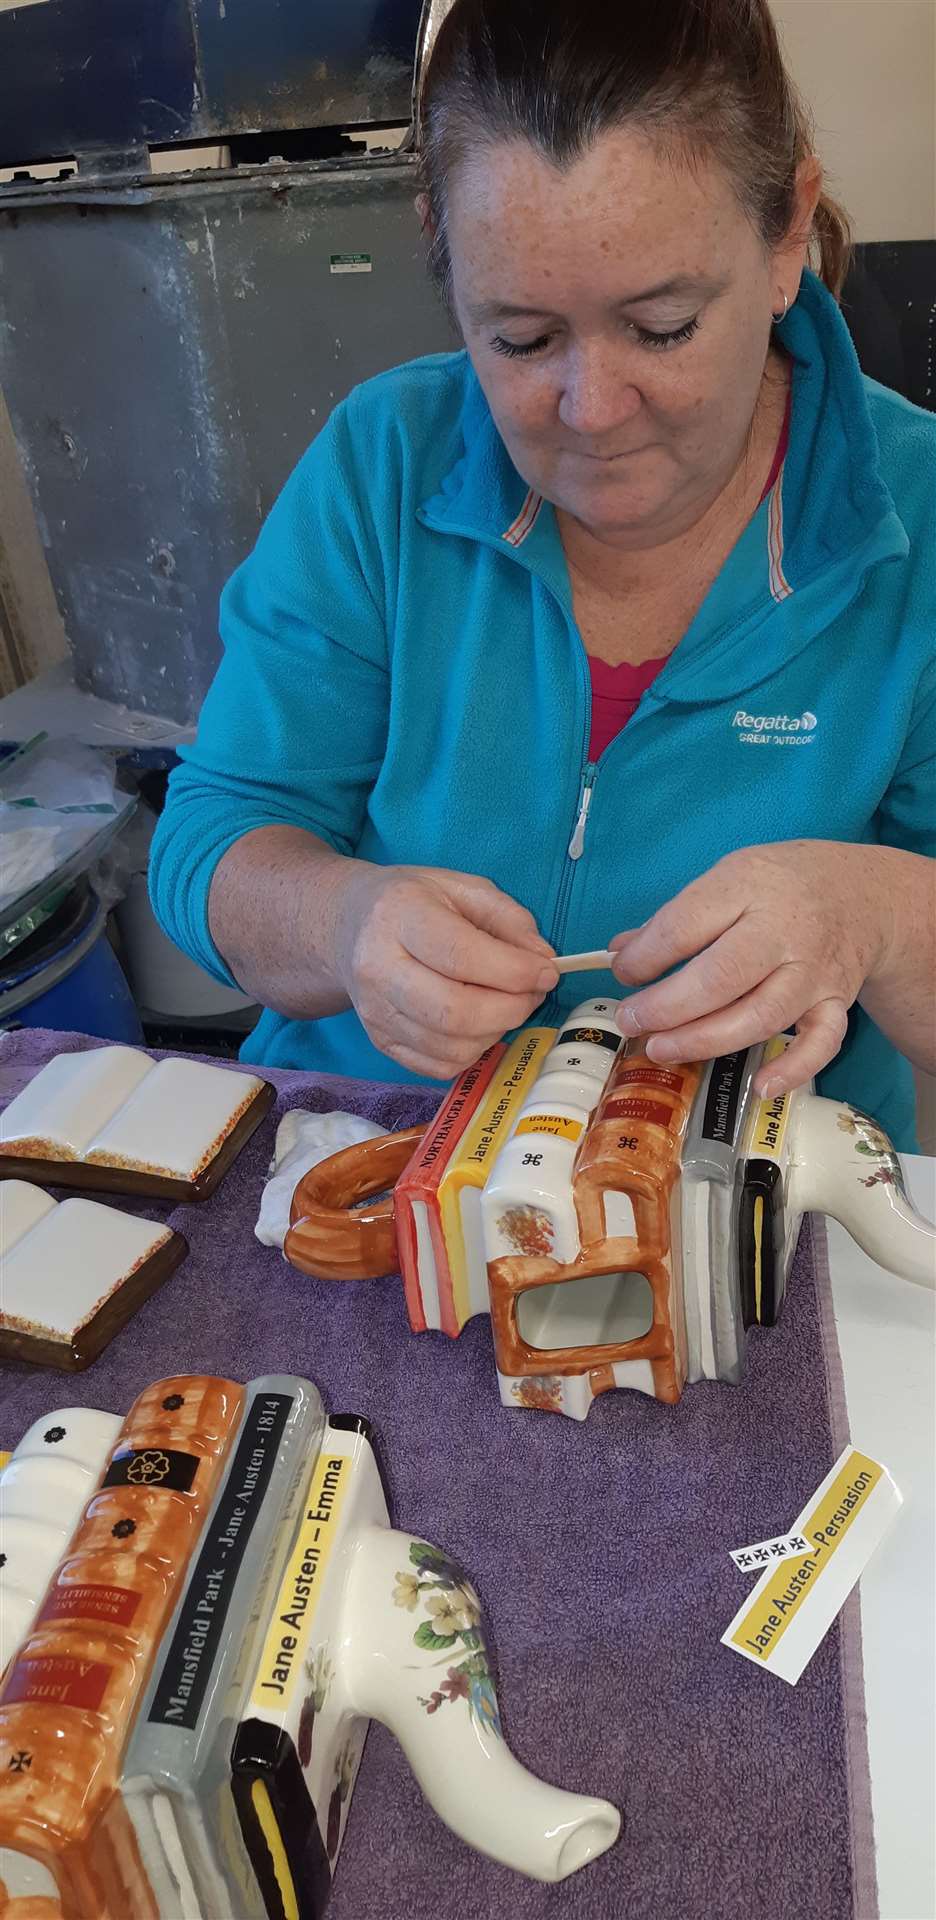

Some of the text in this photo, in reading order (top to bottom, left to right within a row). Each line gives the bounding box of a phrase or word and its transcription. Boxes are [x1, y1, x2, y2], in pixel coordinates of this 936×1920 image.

[732, 711, 800, 732] Regatta
[739, 733, 771, 743] GREAT
[718, 1072, 735, 1092] Park
[468, 1136, 492, 1162] Jane
[482, 1098, 511, 1135] Austen
[504, 1038, 541, 1087] Persuasion
[420, 1098, 465, 1168] NORTHANGER
[460, 1067, 482, 1098] ABBEY
[529, 1115, 573, 1127] Austen
[531, 1126, 560, 1135] Jane
[712, 1092, 731, 1140] Mansfield
[758, 1121, 780, 1150] Jane
[164, 1614, 211, 1722] Mansfield
[197, 1568, 225, 1613] Park
[219, 1505, 246, 1549] Jane
[235, 1448, 265, 1504] Austen
[256, 1400, 280, 1433] 1814
[746, 1614, 782, 1654] Jane
[772, 1560, 817, 1615] Austen
[813, 1471, 873, 1547] Persuasion
[261, 1635, 298, 1695] Jane
[280, 1547, 321, 1630] Austen
[306, 1458, 343, 1522] Emma
[27, 1683, 72, 1700] Jane
